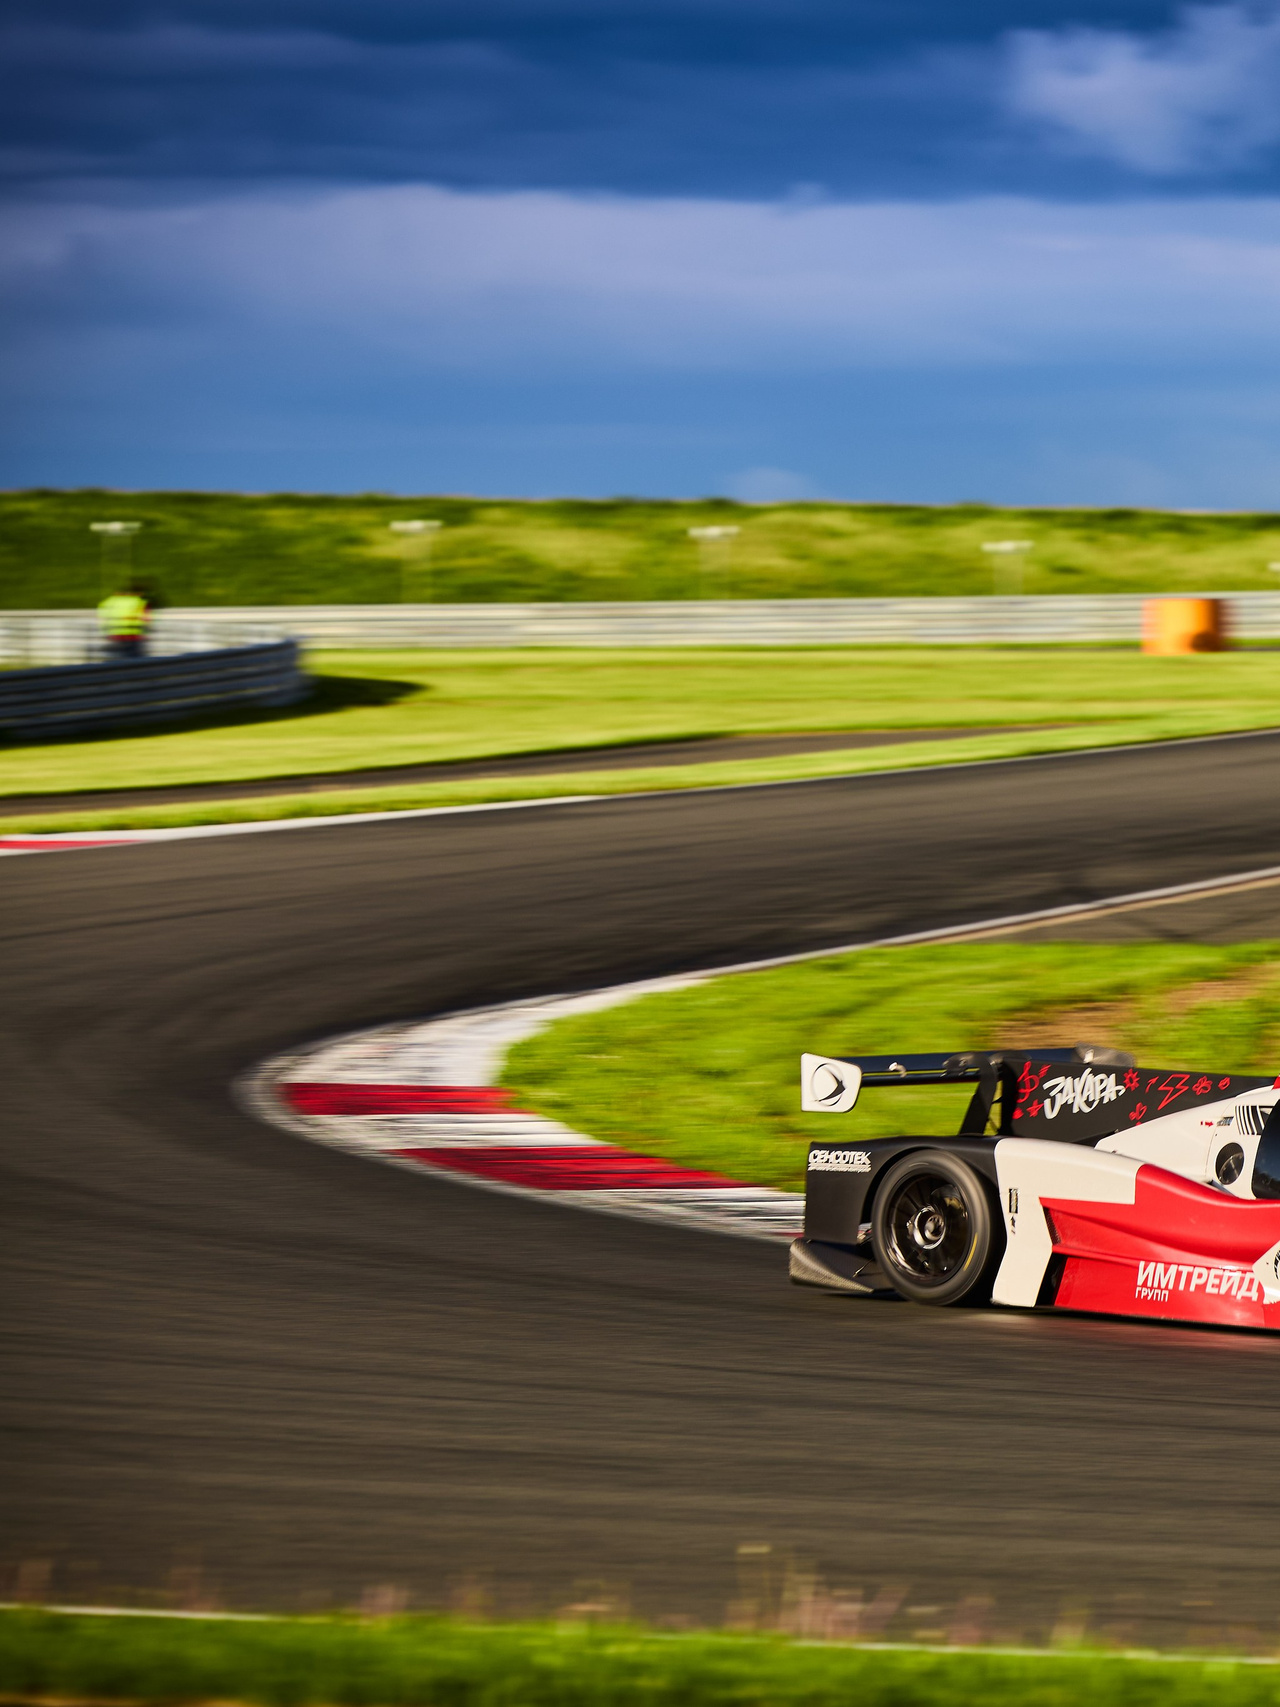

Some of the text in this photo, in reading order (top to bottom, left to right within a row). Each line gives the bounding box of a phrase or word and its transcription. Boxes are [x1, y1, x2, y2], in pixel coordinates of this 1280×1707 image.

[1042, 1067, 1126, 1119] ЗАХАРА
[808, 1150, 871, 1165] СЕНСОТЕК
[1135, 1287, 1169, 1302] ГРУПП
[1136, 1260, 1259, 1302] ИМТРЕЙД
